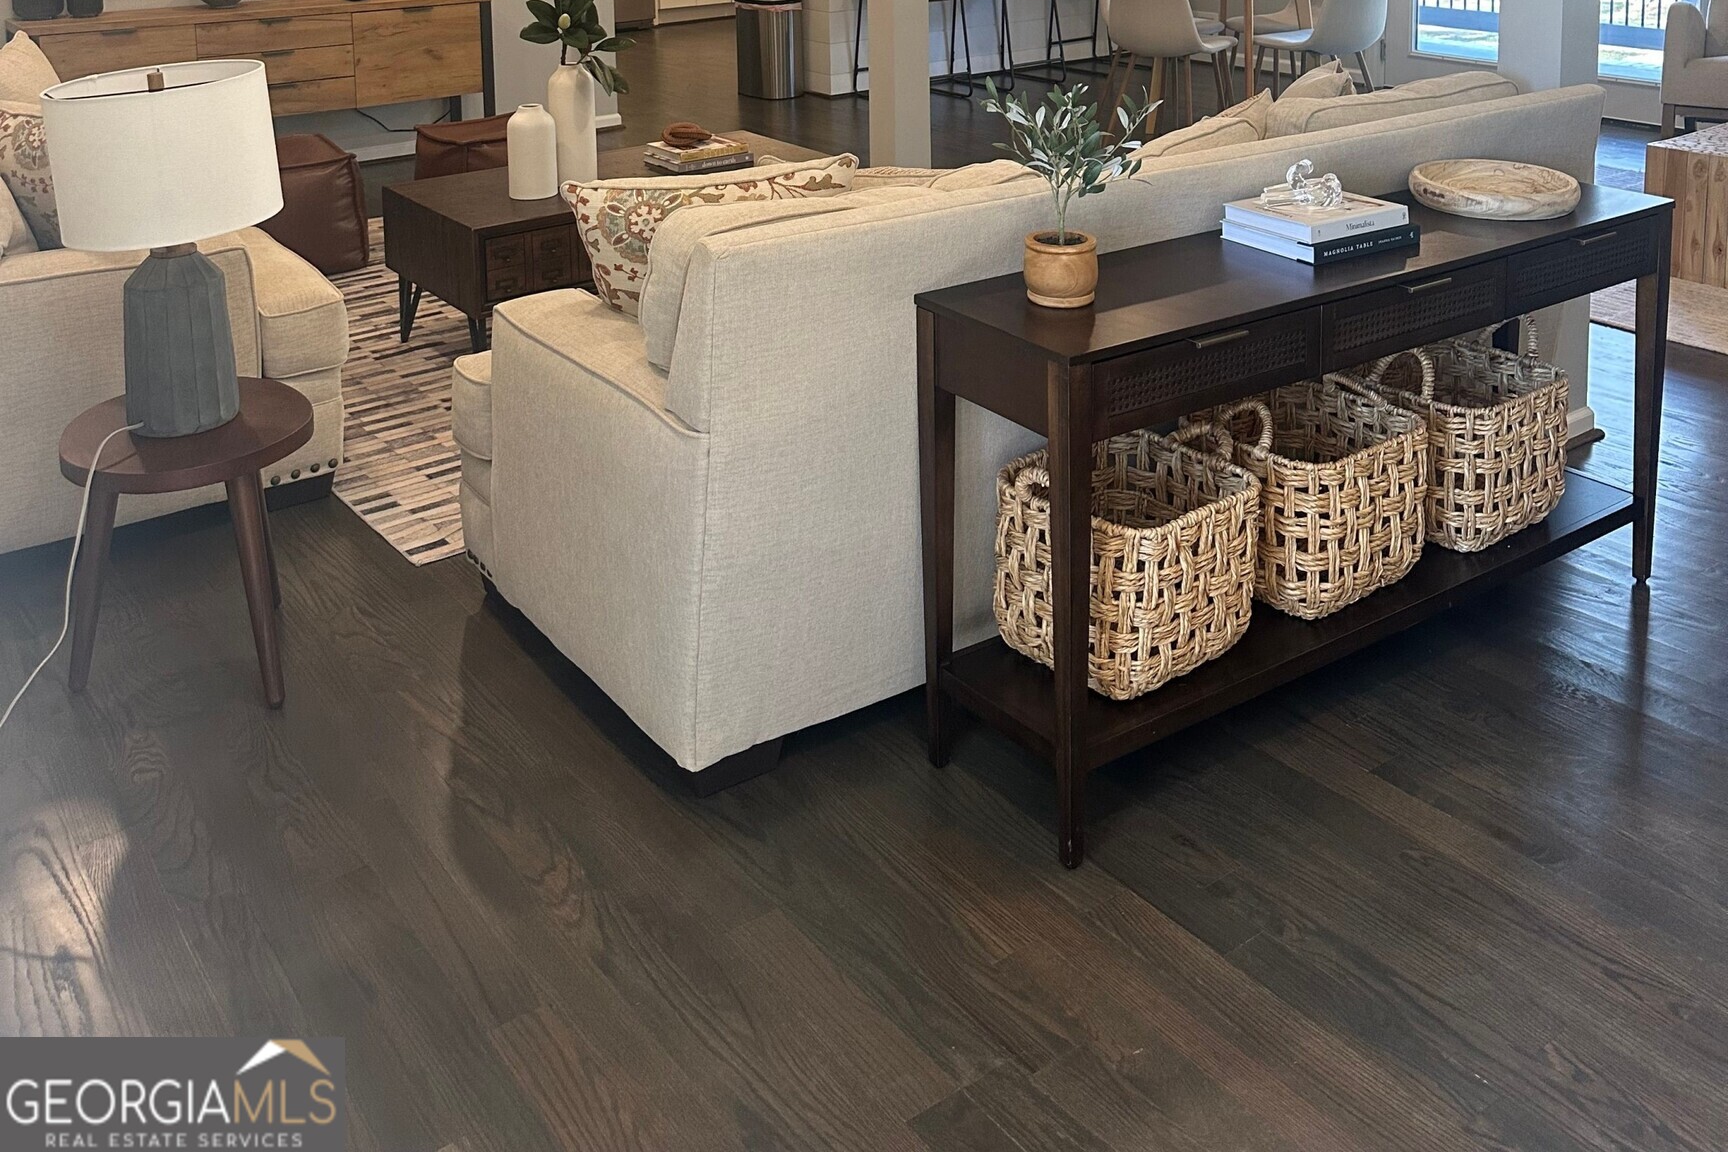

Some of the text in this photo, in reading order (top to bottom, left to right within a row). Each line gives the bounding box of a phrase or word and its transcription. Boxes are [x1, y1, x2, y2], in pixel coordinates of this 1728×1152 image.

[1345, 219, 1375, 232] Minimalista
[1323, 241, 1374, 257] MAGNOLIA TABLE
